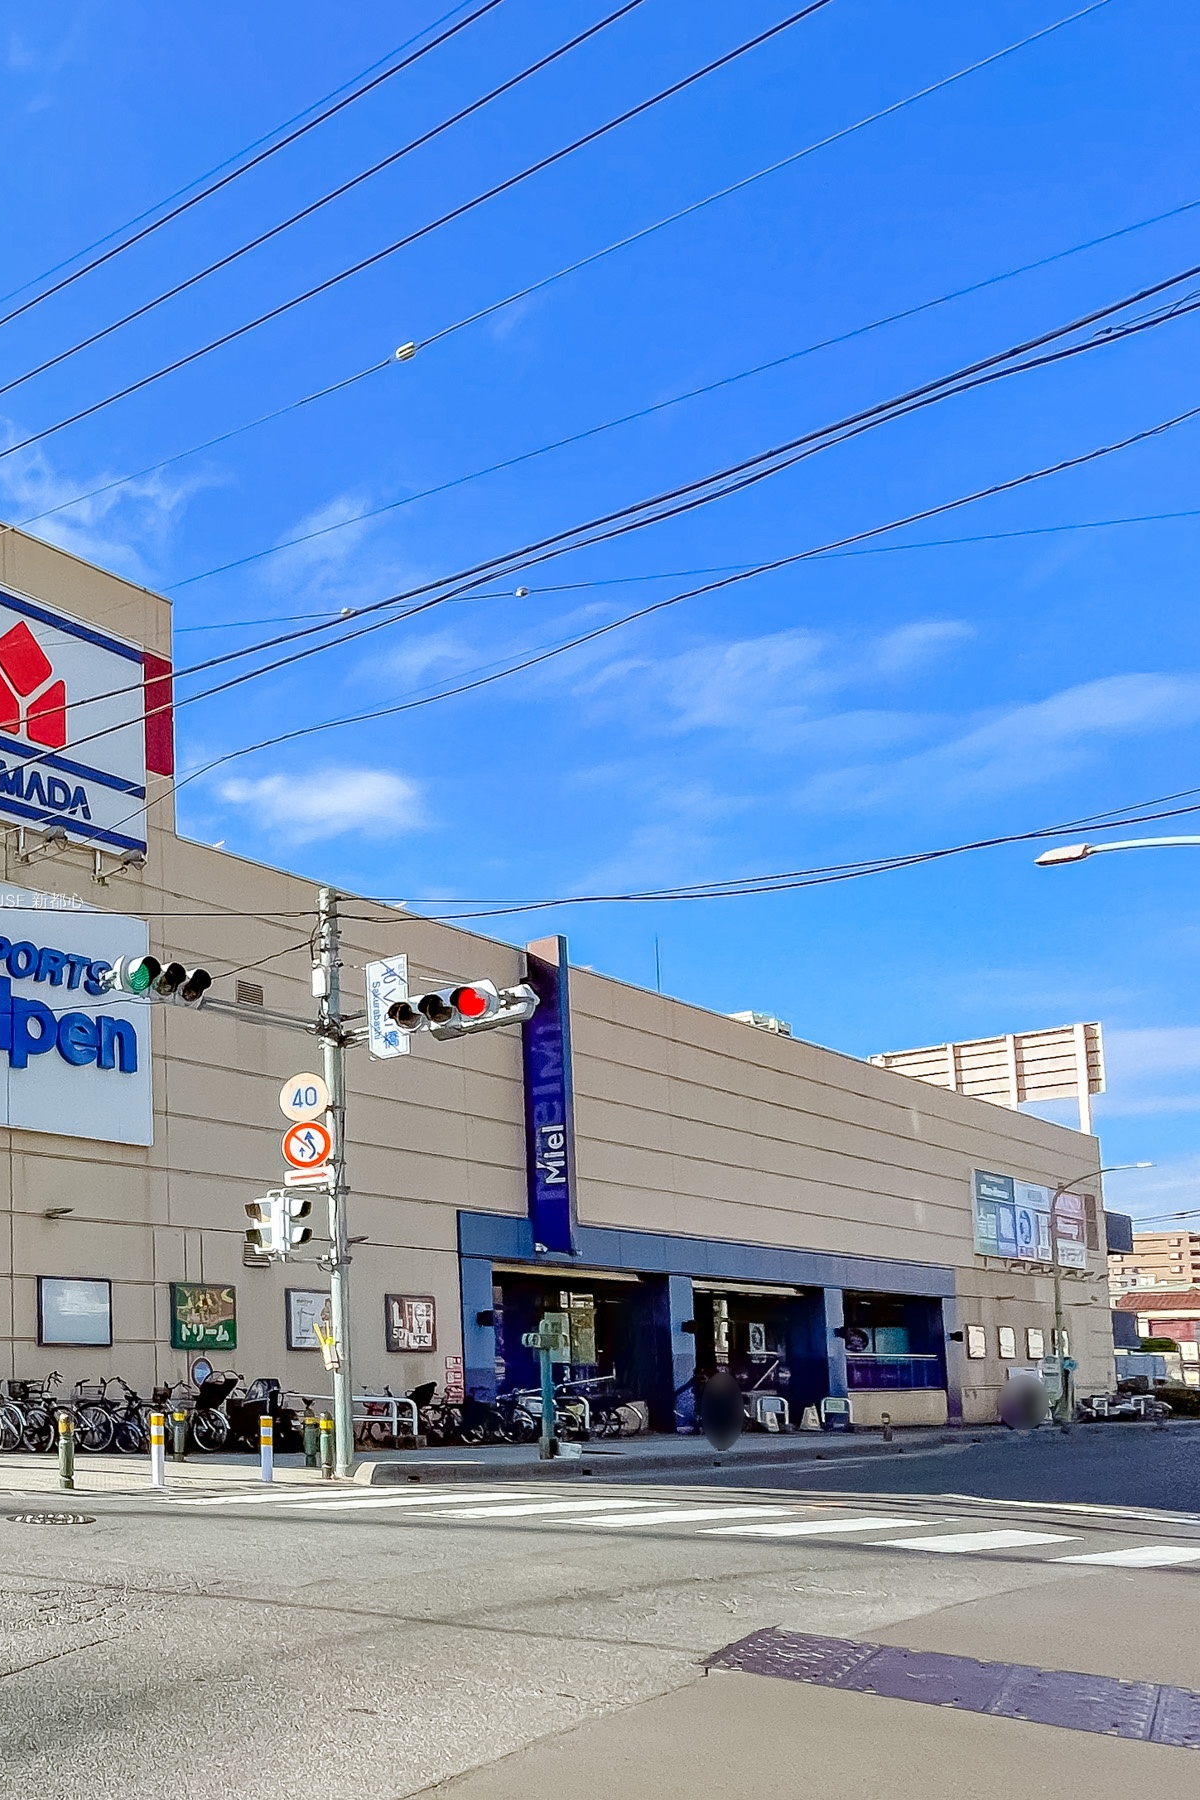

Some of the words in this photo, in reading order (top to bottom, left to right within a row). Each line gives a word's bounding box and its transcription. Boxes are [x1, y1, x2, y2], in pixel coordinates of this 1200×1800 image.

[292, 1086, 318, 1108] 40
[536, 1124, 567, 1184] Miel
[181, 1323, 230, 1342] ドリーム
